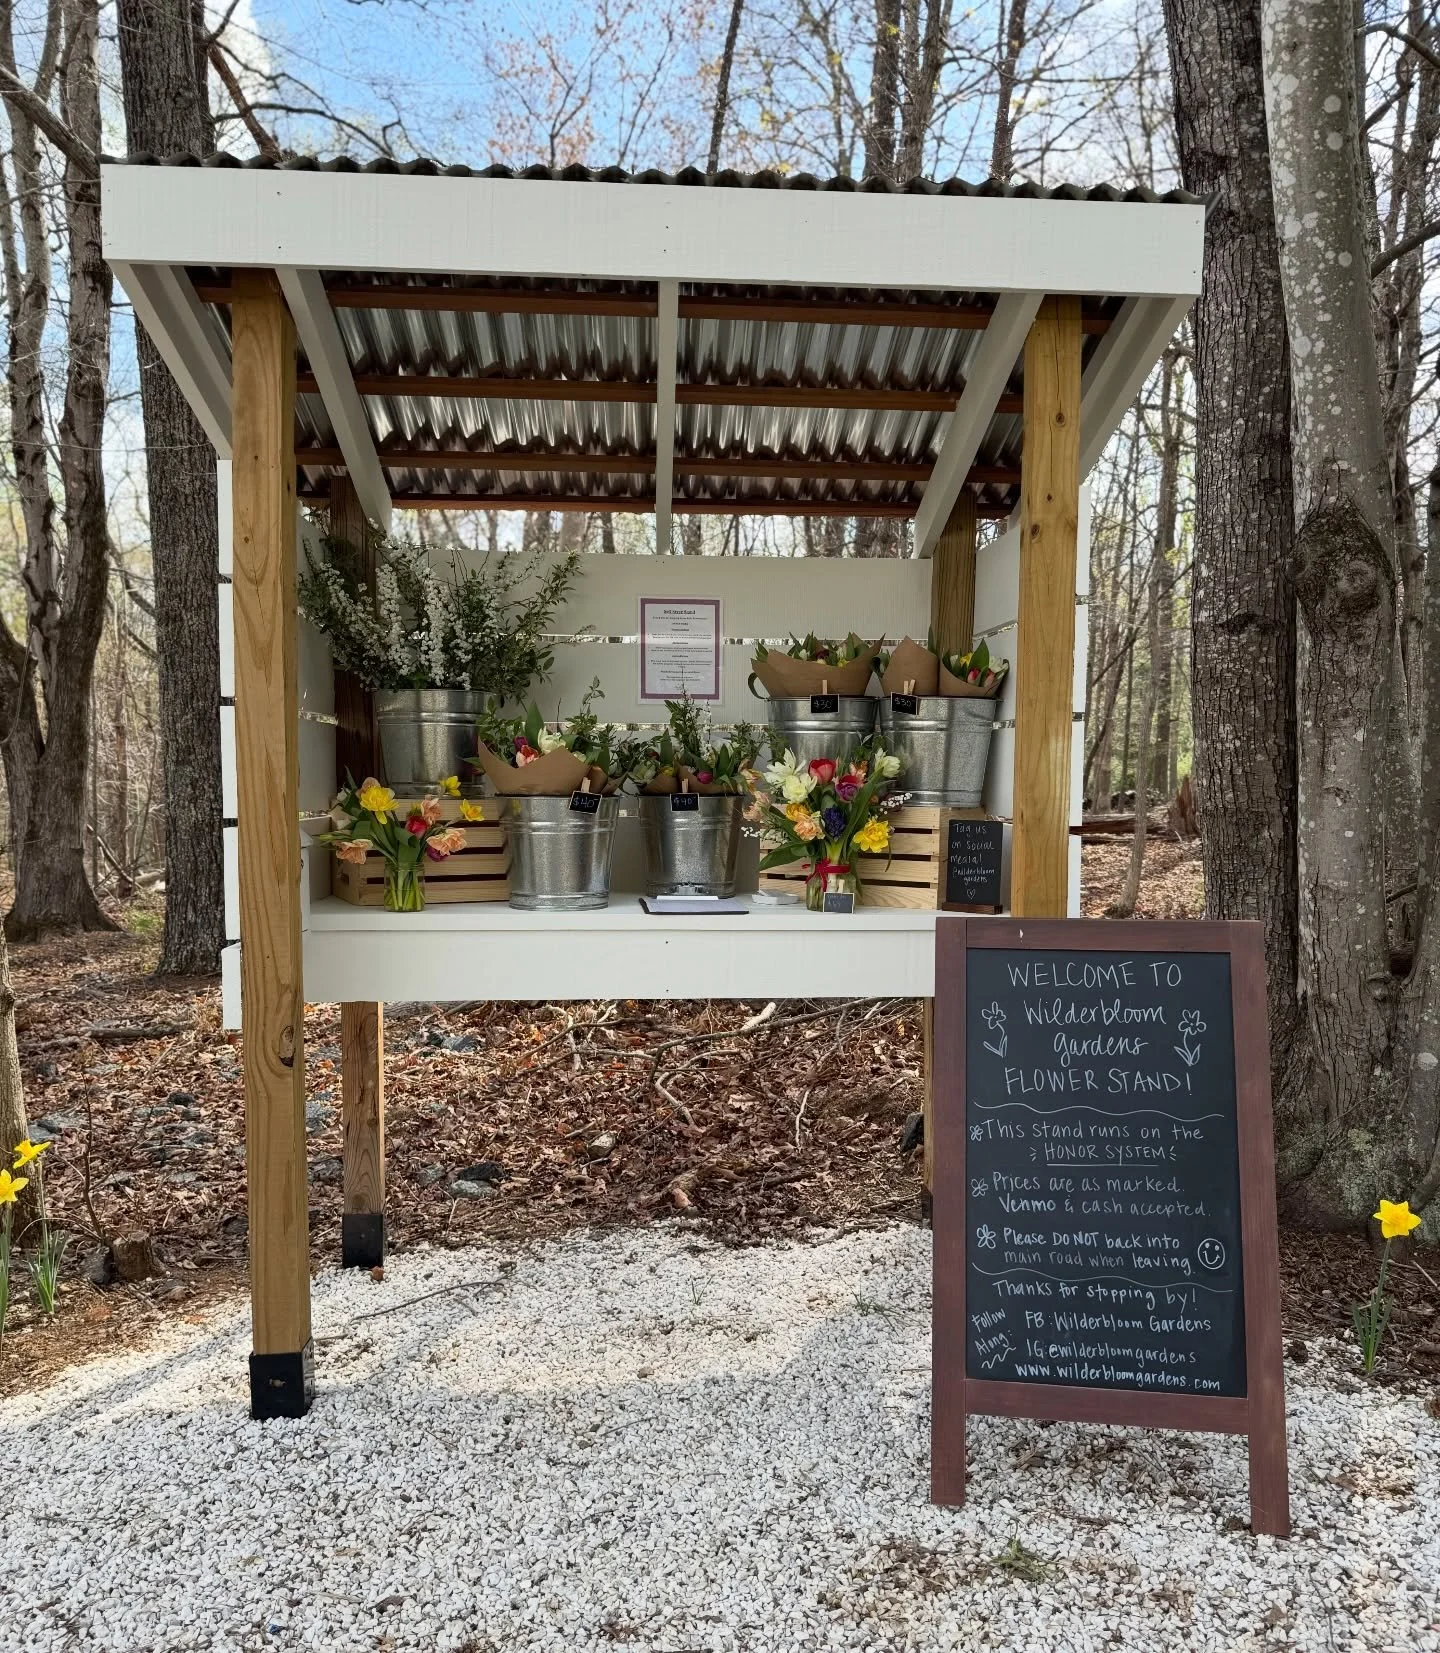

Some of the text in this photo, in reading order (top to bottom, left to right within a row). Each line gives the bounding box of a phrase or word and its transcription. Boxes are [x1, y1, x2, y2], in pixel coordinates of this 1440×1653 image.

[953, 823, 988, 838] Tag us
[951, 841, 961, 849] on
[1007, 961, 1182, 989] WELCOME TO
[1023, 998, 1167, 1026] Wilderbloom
[1004, 1067, 1193, 1096] FLOWER STAND!
[981, 1119, 1204, 1140] This stand runs on the
[1044, 1142, 1166, 1166] HONOR SYSTEM
[992, 1171, 1185, 1193] Prices are as marked.
[998, 1194, 1212, 1217] Venmo & cash accepted.
[1003, 1227, 1180, 1249] Please DO NOT back into
[1004, 1248, 1197, 1276] main road when leaving.
[992, 1279, 1198, 1314] Thanks for stopping by!
[971, 1307, 1007, 1332] Follow
[1149, 1315, 1212, 1333] Gardens
